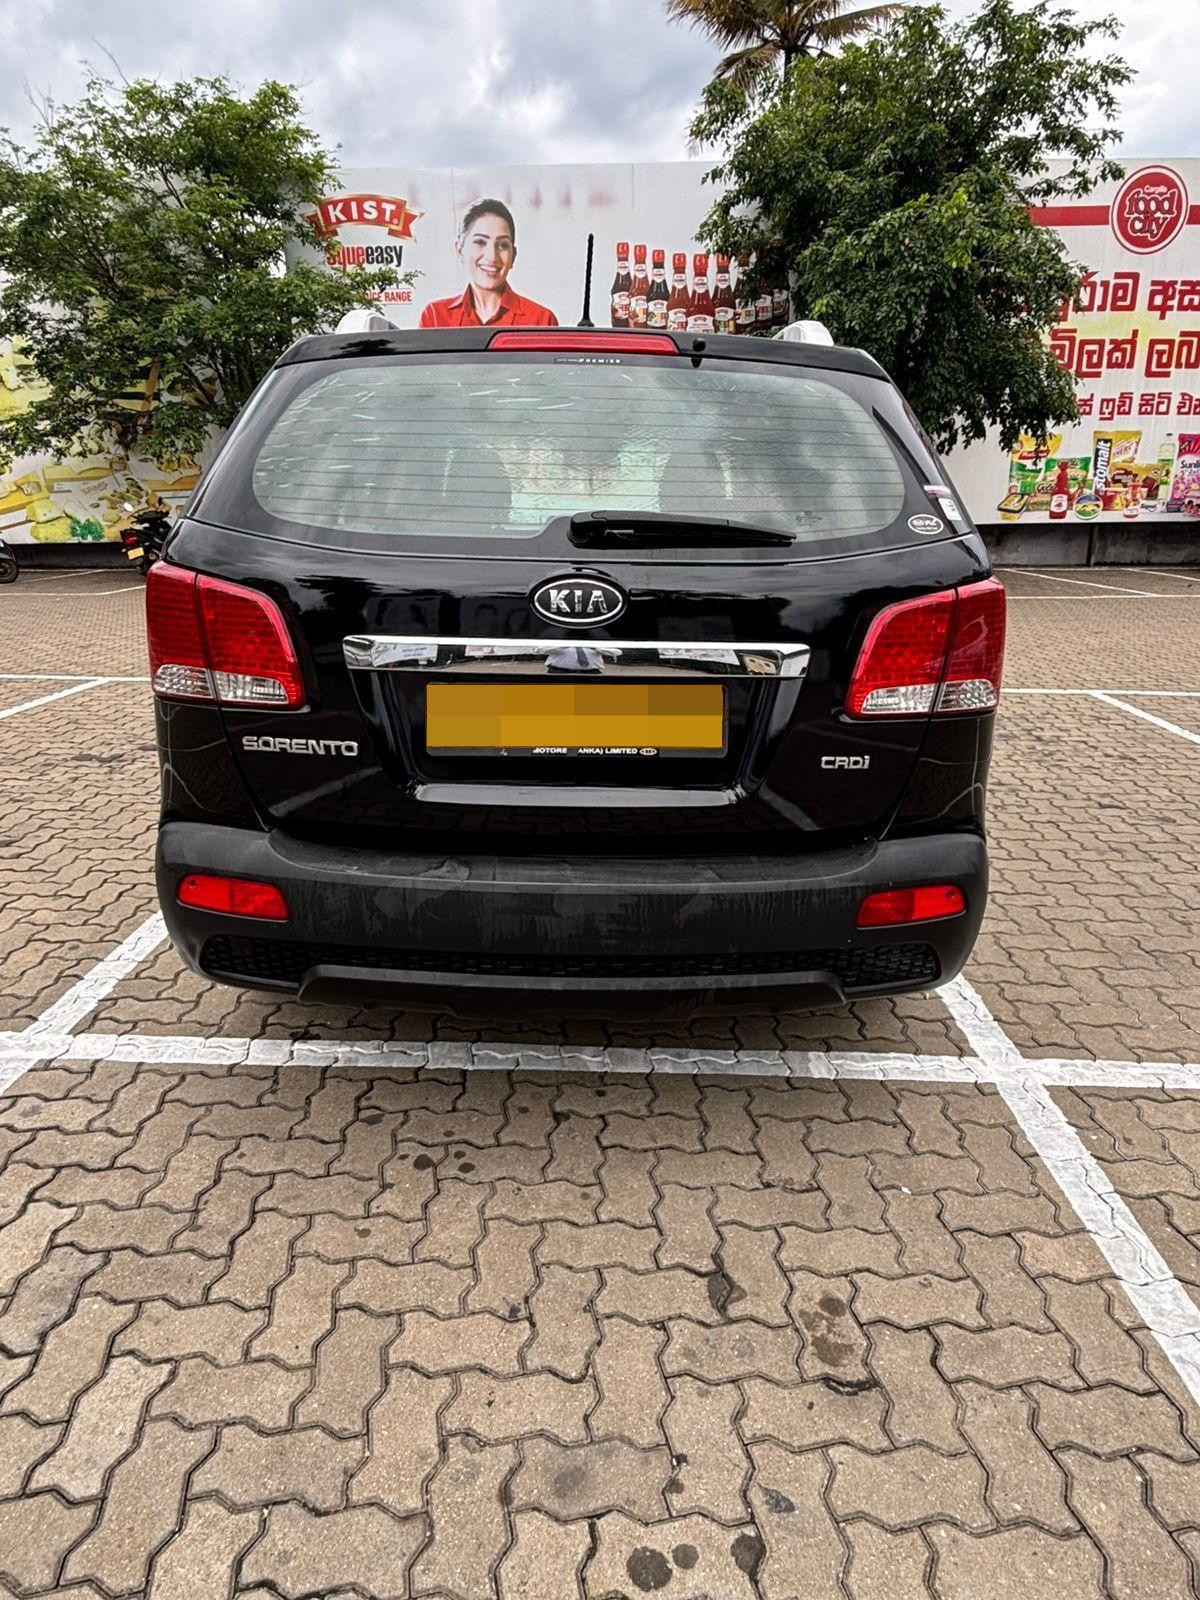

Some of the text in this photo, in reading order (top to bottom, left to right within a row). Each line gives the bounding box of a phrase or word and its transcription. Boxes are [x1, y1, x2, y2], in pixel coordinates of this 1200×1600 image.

[327, 201, 397, 223] KIST
[384, 291, 412, 302] RANGE
[548, 589, 608, 614] KIA
[242, 736, 358, 756] SORENTO
[578, 747, 603, 755] ANKA)
[605, 747, 638, 755] LIMITED
